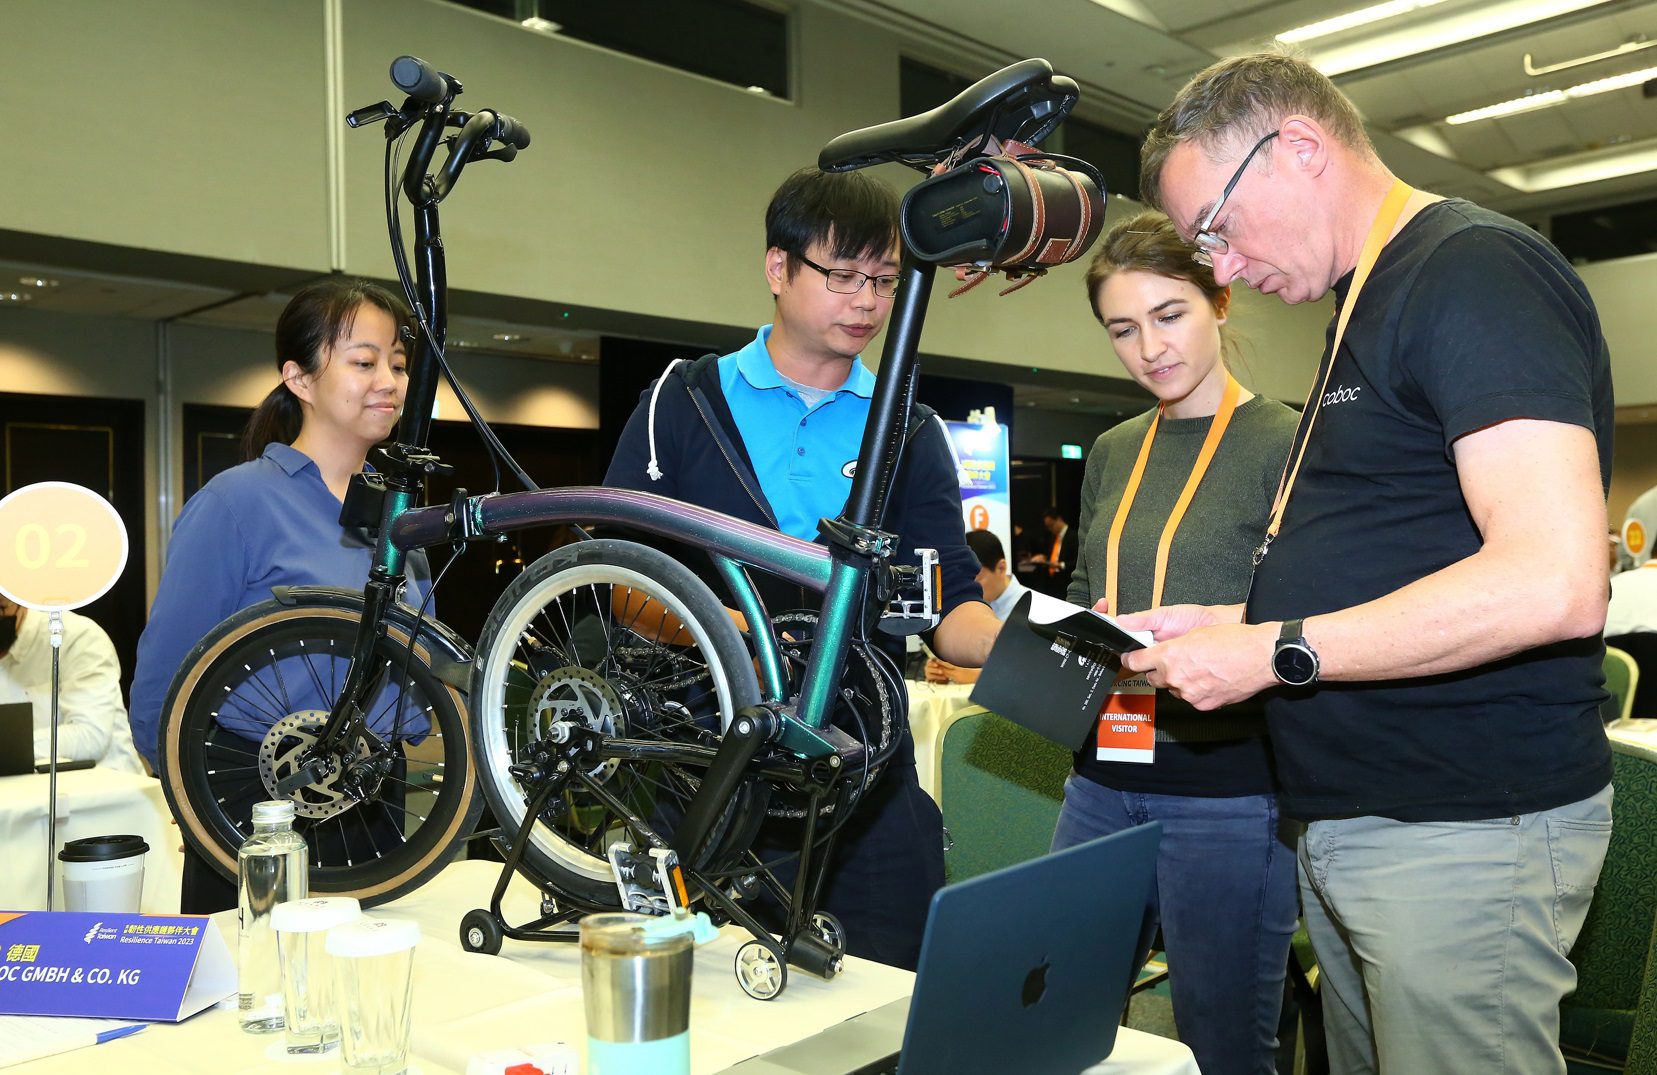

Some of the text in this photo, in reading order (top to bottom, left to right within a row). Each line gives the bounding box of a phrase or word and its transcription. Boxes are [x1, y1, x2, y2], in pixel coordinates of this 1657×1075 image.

[1322, 385, 1361, 407] coboc
[15, 522, 89, 570] 02
[1100, 713, 1152, 722] INTERNATIONAL
[1111, 724, 1138, 733] VISITOR
[120, 936, 152, 945] Resilience
[154, 937, 177, 945] Taiwan
[6, 944, 41, 963] 德國
[21, 966, 71, 984] GMBH
[70, 967, 84, 984] &
[87, 968, 113, 985] CO.
[117, 969, 141, 986] KG
